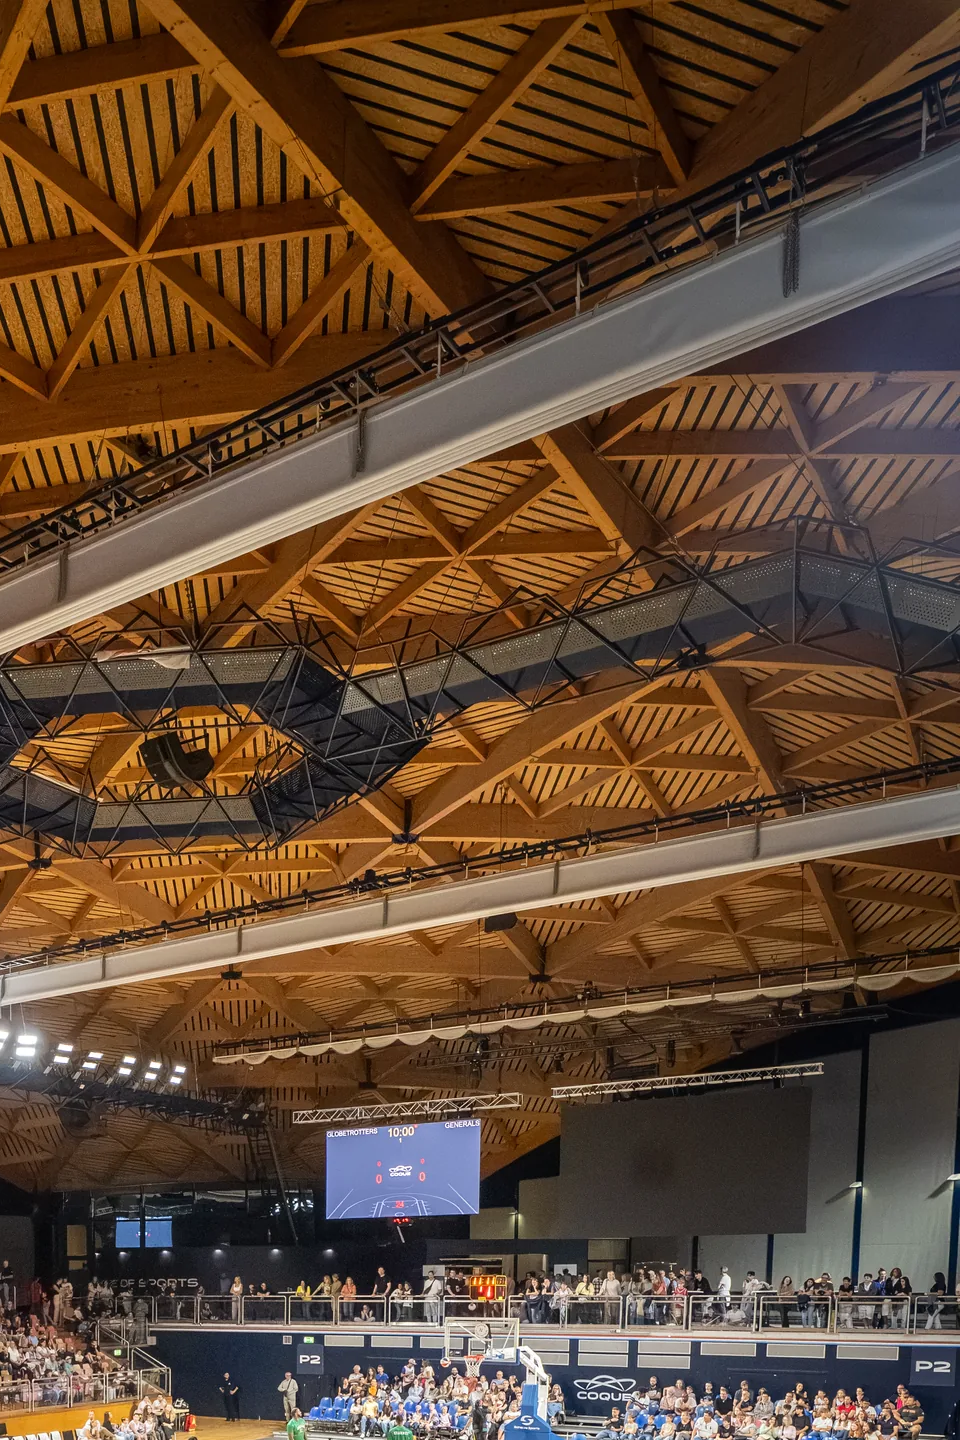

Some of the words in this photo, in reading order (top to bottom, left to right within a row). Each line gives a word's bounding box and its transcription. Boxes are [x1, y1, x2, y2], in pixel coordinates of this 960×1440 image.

[444, 1119, 481, 1129] GENERALS
[326, 1127, 378, 1138] GLOBETROTTERS
[388, 1126, 415, 1138] 10:00
[375, 1174, 383, 1185] 0
[418, 1171, 426, 1182] 0
[299, 1354, 321, 1365] P2
[915, 1360, 951, 1373] P2
[577, 1391, 631, 1401] COQUE
